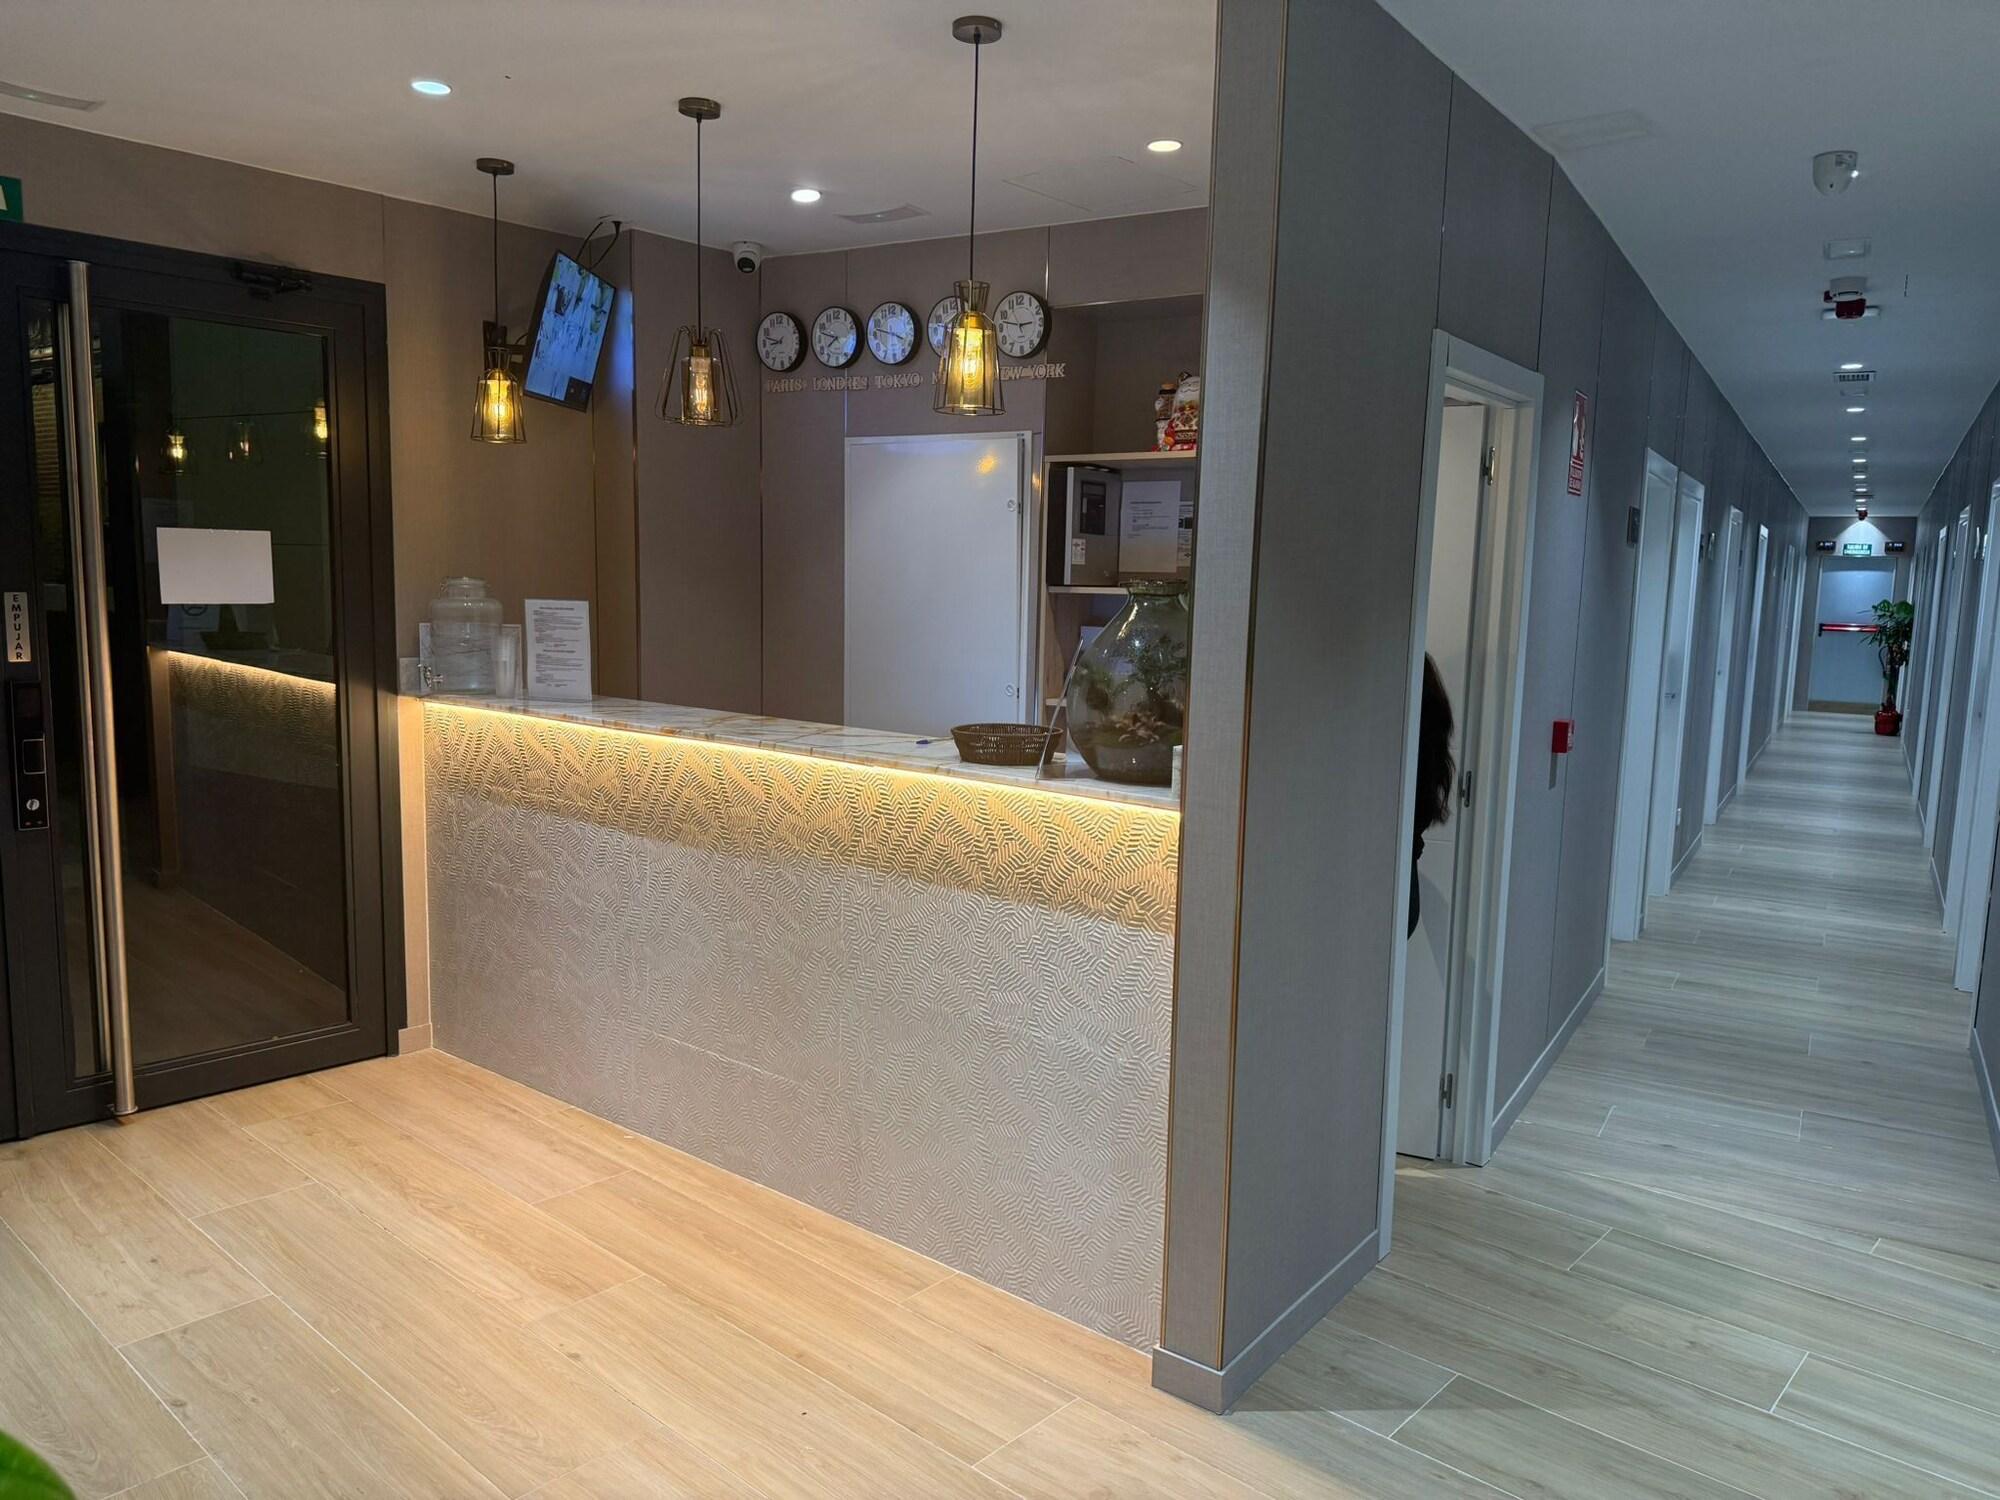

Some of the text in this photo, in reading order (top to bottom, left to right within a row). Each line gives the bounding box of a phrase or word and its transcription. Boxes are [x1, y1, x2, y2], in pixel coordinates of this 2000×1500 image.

[1016, 296, 1024, 305] 12
[833, 311, 840, 320] 12
[888, 305, 896, 315] 12
[1000, 310, 1008, 320] 10
[776, 315, 784, 324] 12
[1029, 363, 1067, 379] YORK
[767, 379, 802, 393] PARIS
[813, 376, 869, 392] LONDRES
[874, 373, 921, 389] TOKYO
[11, 593, 23, 660] EMPUJAR
